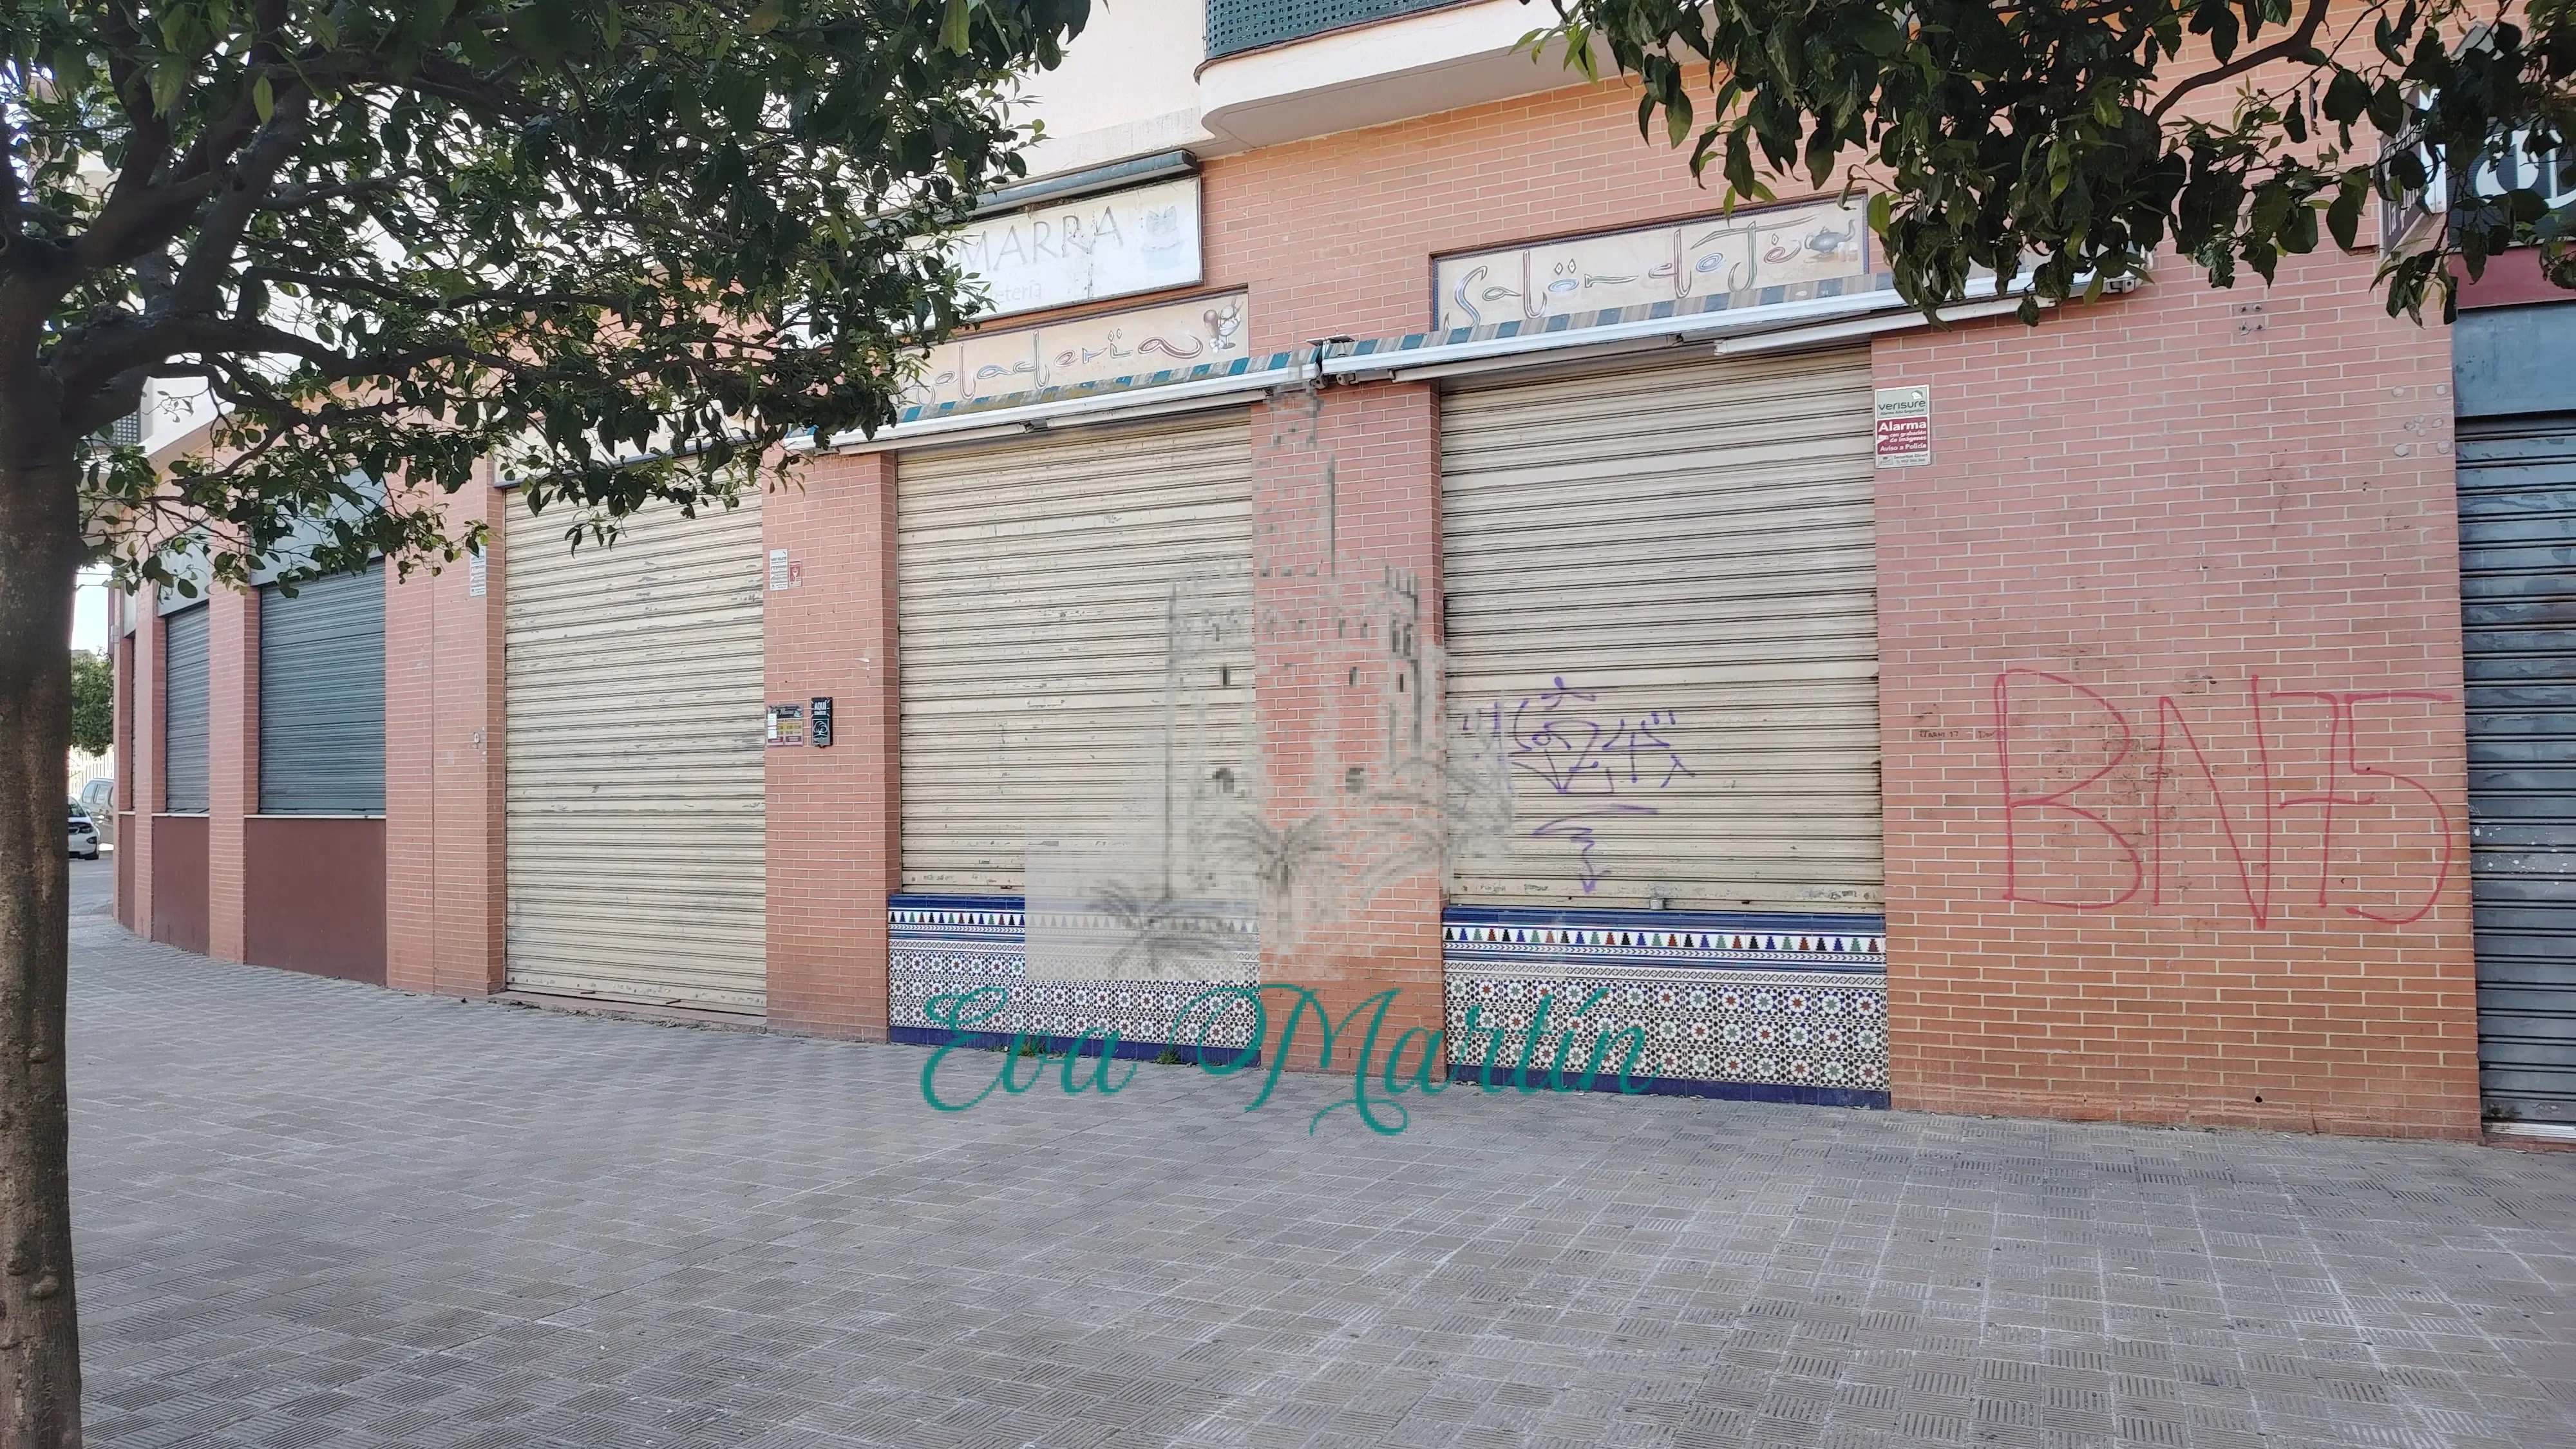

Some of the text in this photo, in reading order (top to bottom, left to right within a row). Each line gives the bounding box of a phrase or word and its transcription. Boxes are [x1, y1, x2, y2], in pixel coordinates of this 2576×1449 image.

[1878, 400, 1926, 411] verisure
[1878, 421, 1927, 433] Alarma
[814, 699, 827, 711] AQUÍ
